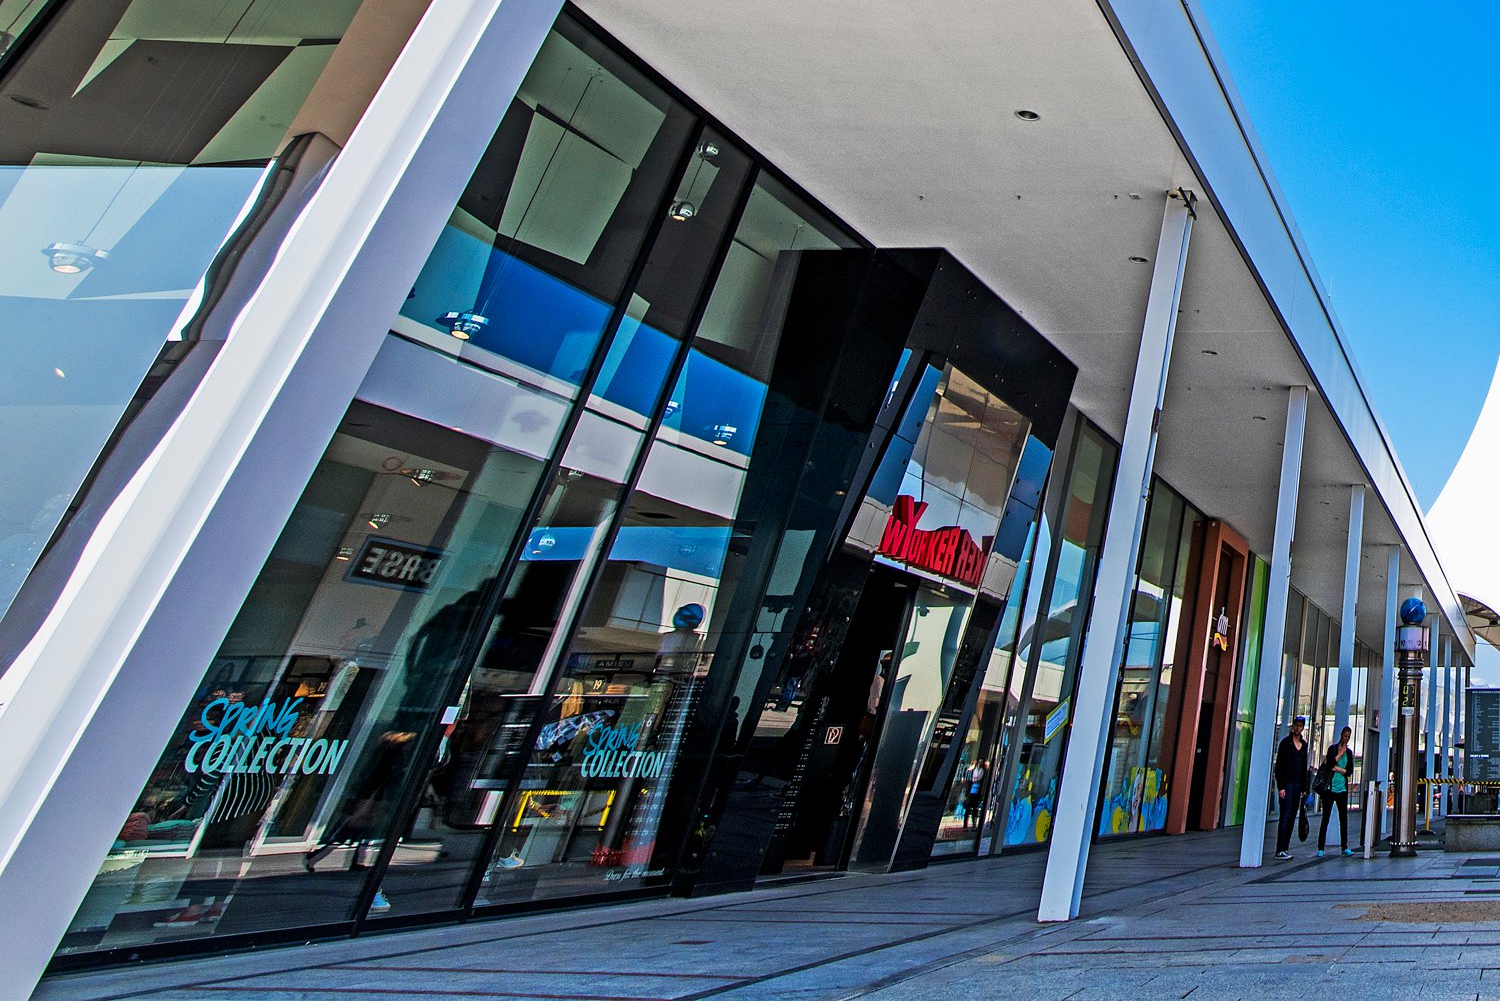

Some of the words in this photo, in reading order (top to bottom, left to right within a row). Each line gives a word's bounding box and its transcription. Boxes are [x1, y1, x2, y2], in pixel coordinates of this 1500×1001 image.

[189, 697, 304, 743] SPRING
[583, 721, 642, 756] SPRING
[184, 735, 350, 775] COLLECTION
[580, 750, 667, 778] COLLECTION
